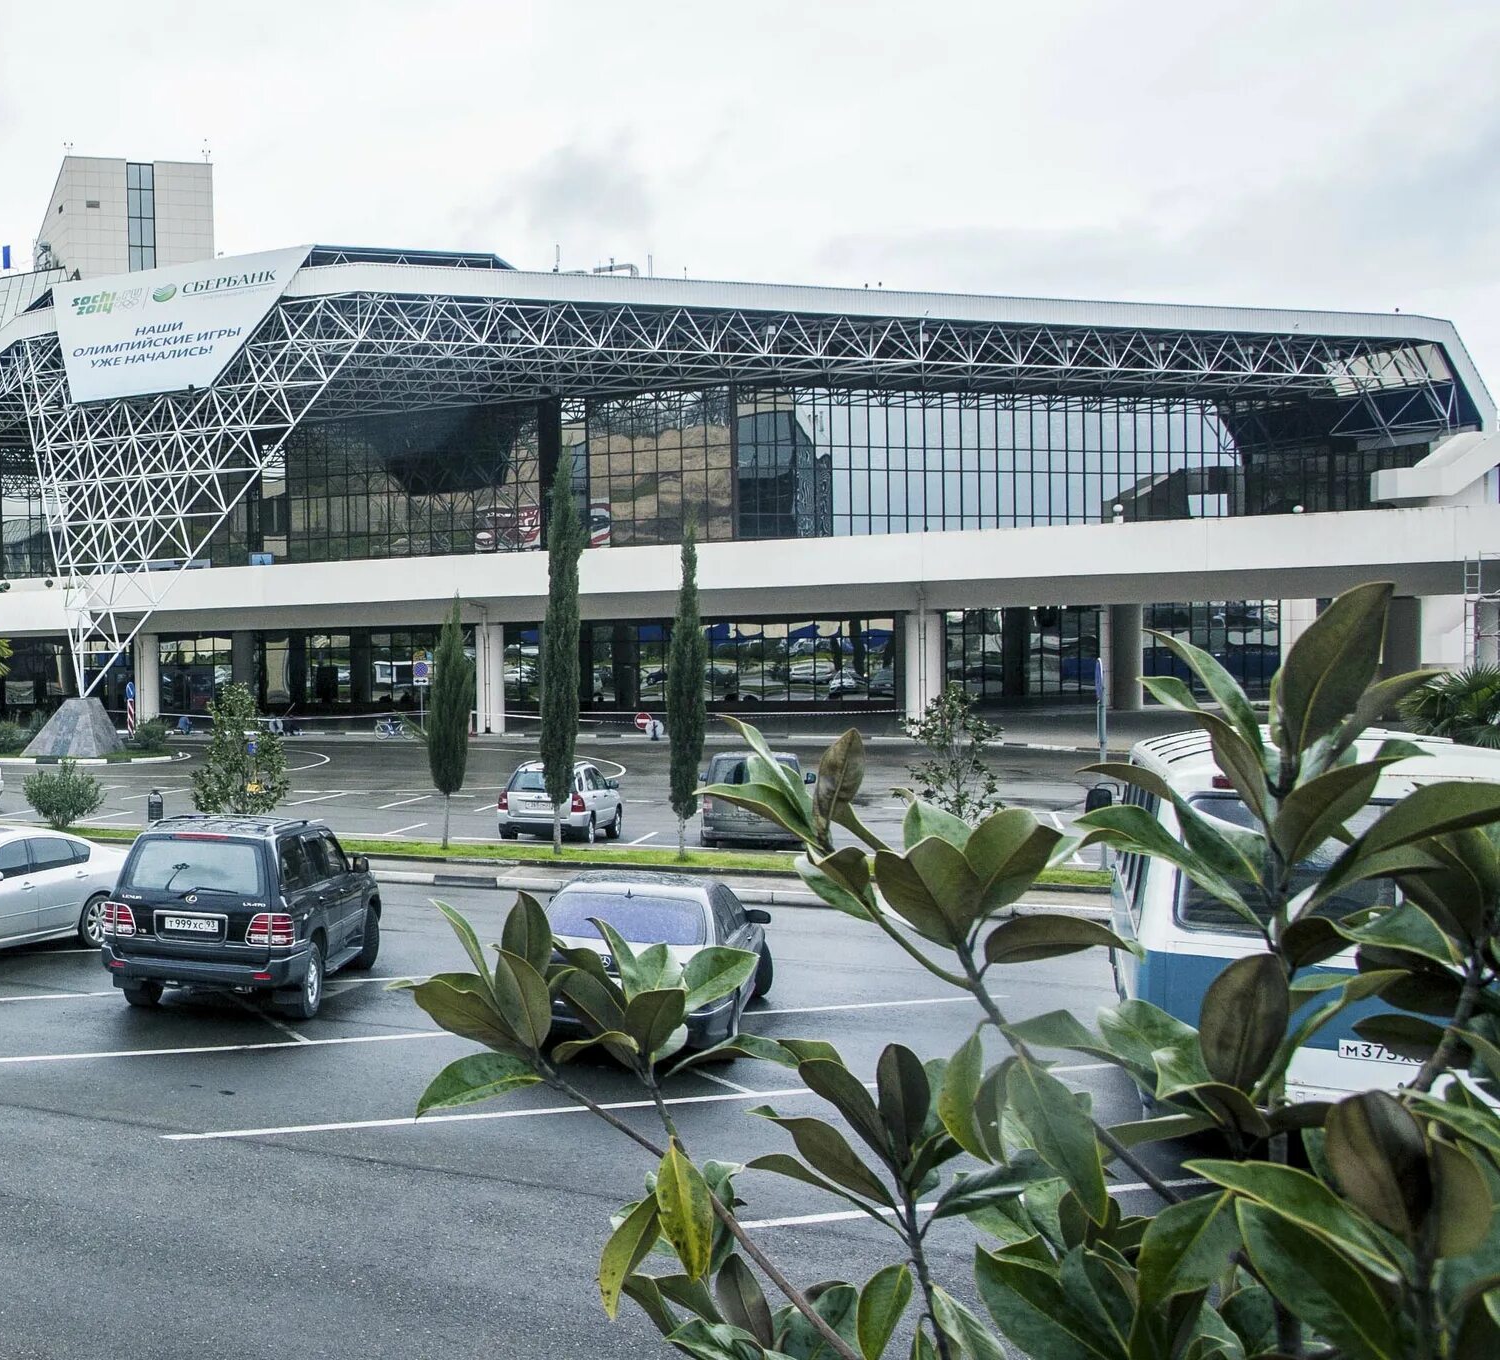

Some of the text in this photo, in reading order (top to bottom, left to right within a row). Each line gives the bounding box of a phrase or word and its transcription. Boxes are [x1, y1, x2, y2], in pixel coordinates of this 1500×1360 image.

[182, 269, 277, 294] СБЕРБАНК
[71, 291, 117, 307] sochi
[135, 321, 184, 337] НАШИ
[72, 327, 242, 358] ОЛИМПИЙСКИЕ ИГРЫ
[90, 345, 213, 368] УЖЕ НАЧАЛИСЬ!
